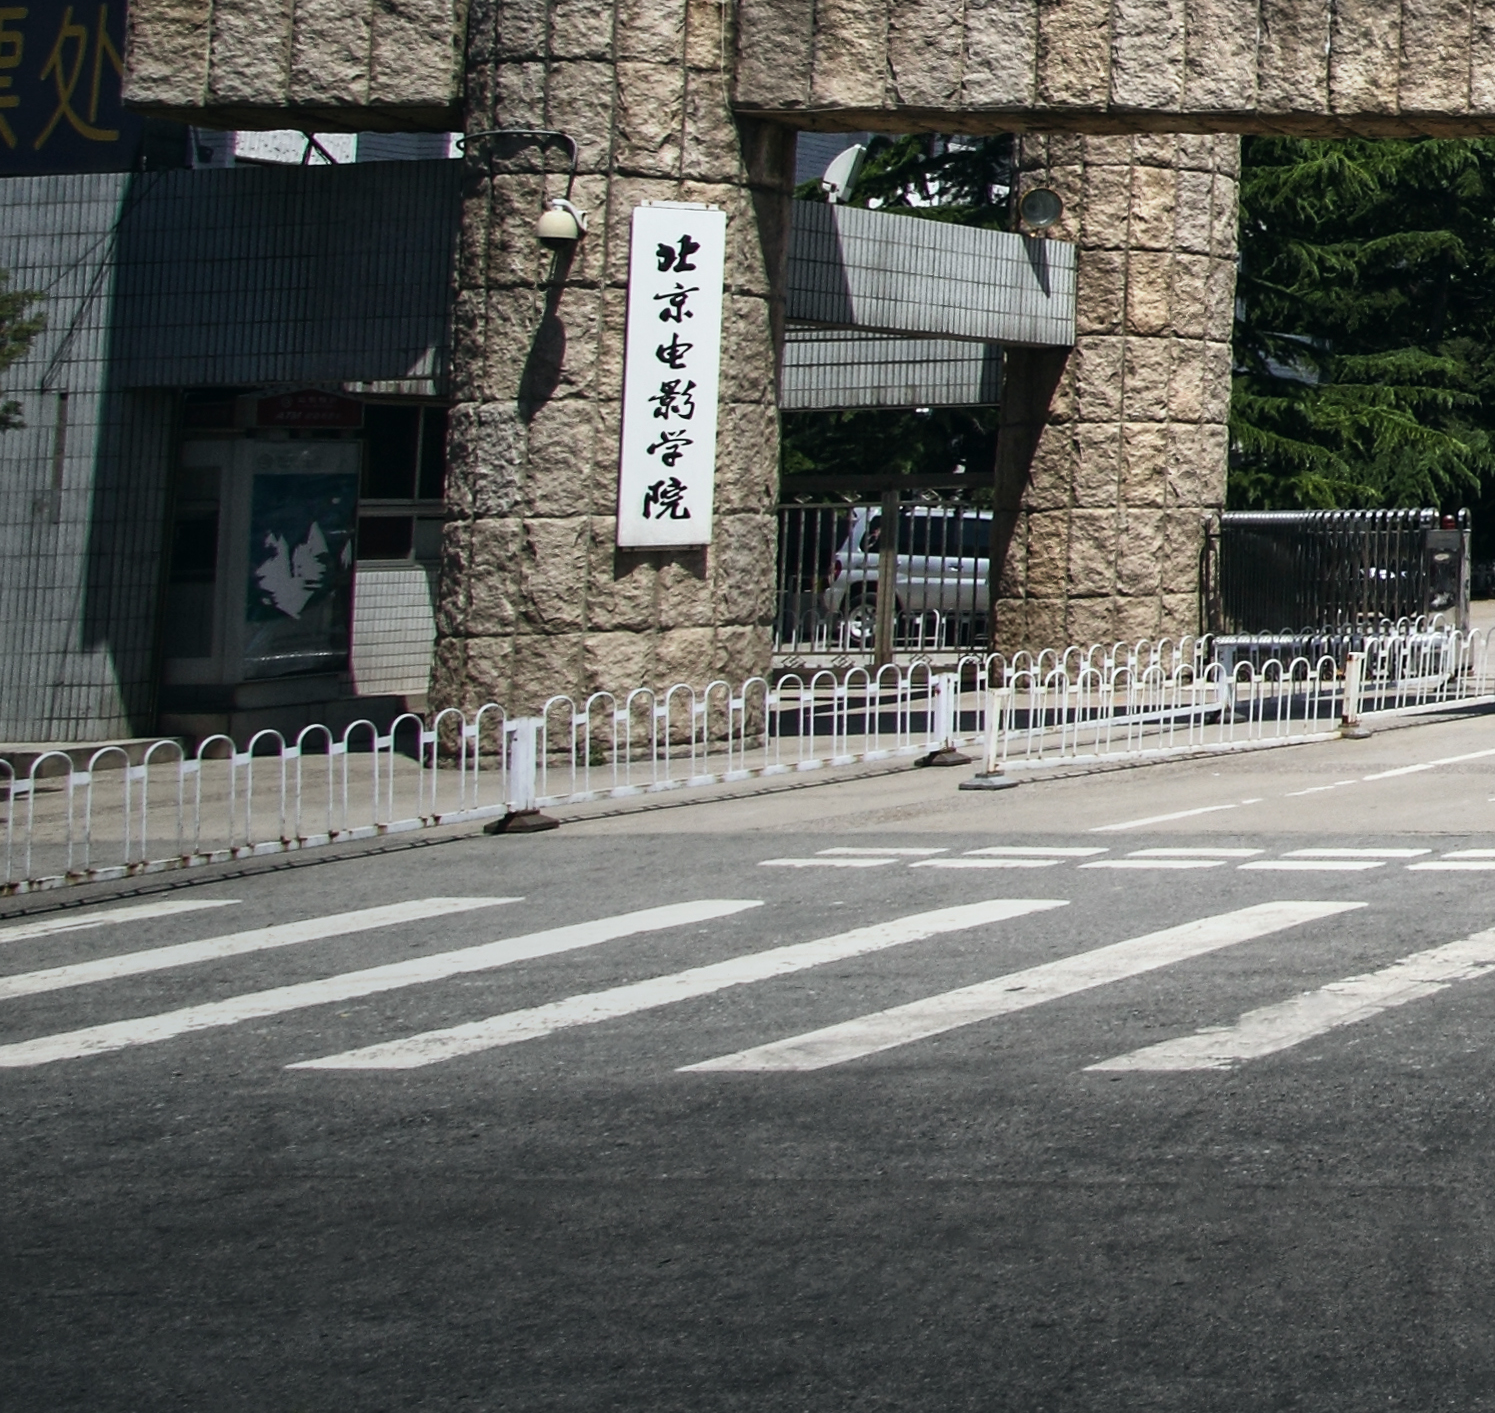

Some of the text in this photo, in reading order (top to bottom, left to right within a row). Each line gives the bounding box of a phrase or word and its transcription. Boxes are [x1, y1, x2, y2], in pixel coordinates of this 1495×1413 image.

[642, 234, 701, 519] 北京电影学院
